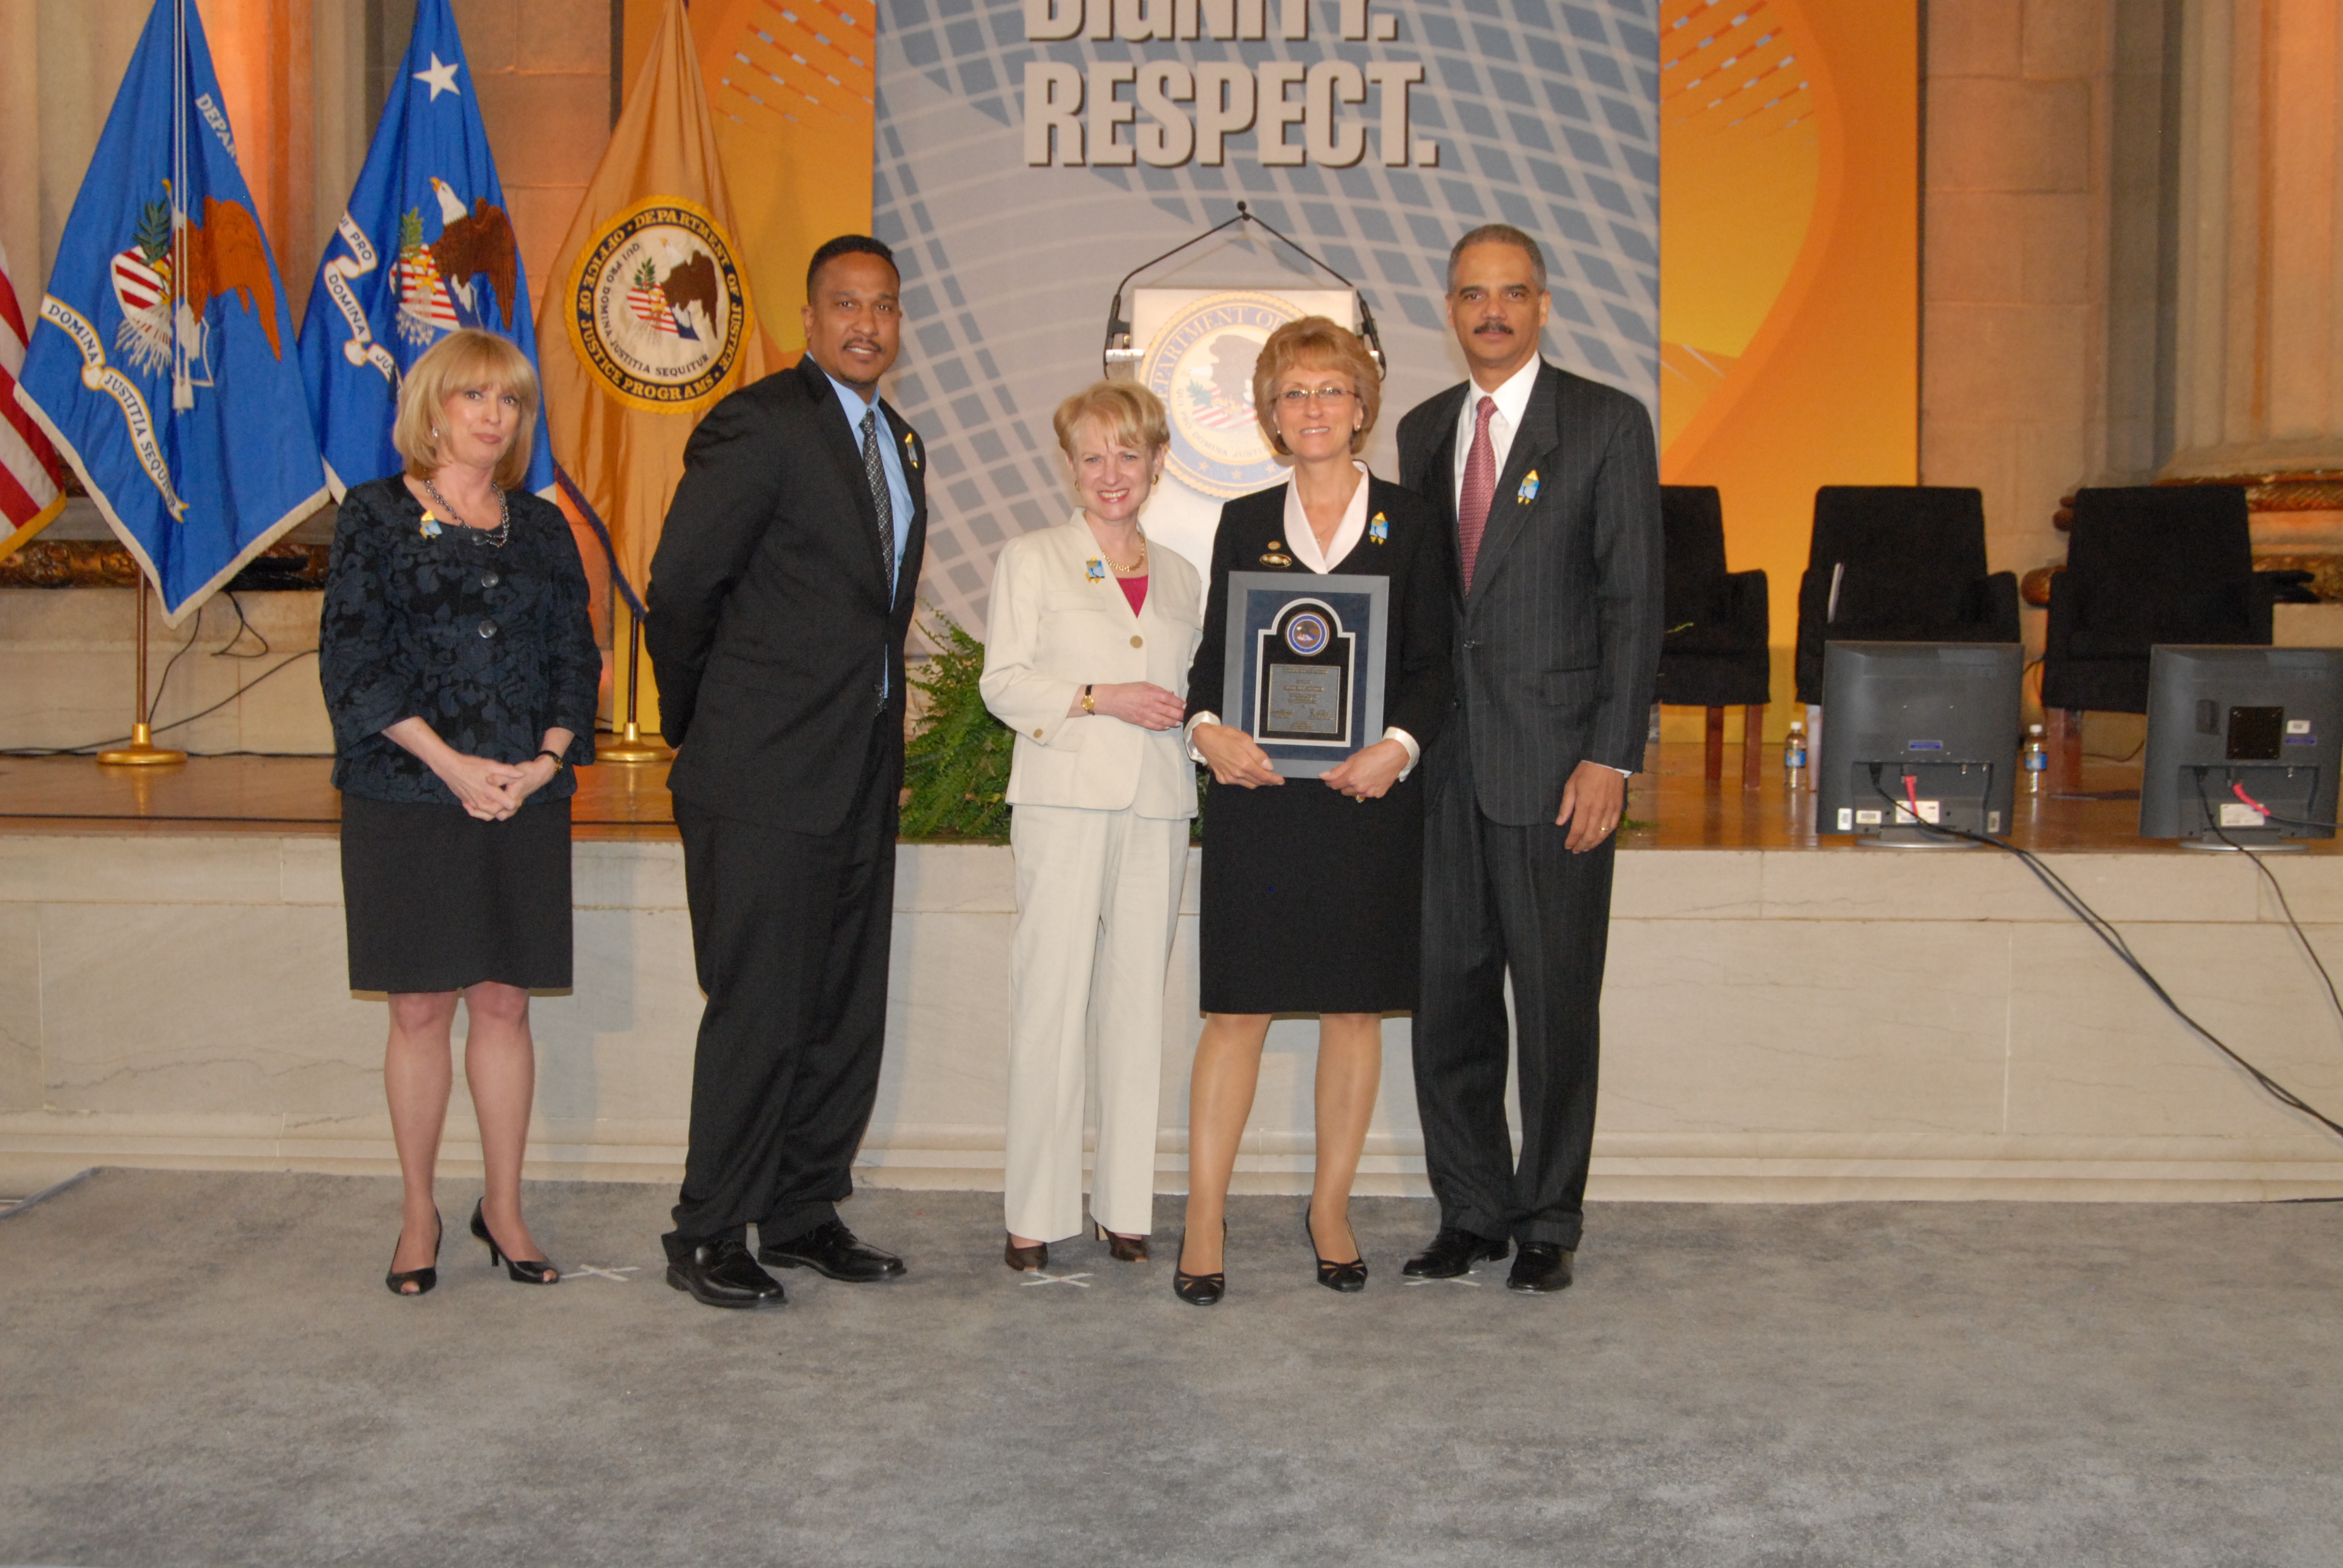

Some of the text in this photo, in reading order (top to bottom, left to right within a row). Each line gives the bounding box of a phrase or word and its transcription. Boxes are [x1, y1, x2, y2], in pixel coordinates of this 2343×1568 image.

[195, 92, 237, 162] DEPAR
[1024, 59, 1440, 169] RESPECT.
[350, 231, 372, 261] PRO
[635, 209, 742, 371] DEPARTMENT OF JUSTICE
[328, 274, 365, 336] DOMINA
[579, 228, 715, 400] OFFICE OF JUSTICE PROGRAMS
[600, 287, 613, 338] DOMINA
[609, 339, 651, 374] JUSTITIA
[655, 353, 710, 377] SEQUITUR
[47, 304, 100, 363] DOMINA
[104, 374, 148, 437] JUSTITIA
[1191, 431, 1228, 457] DOMINA
